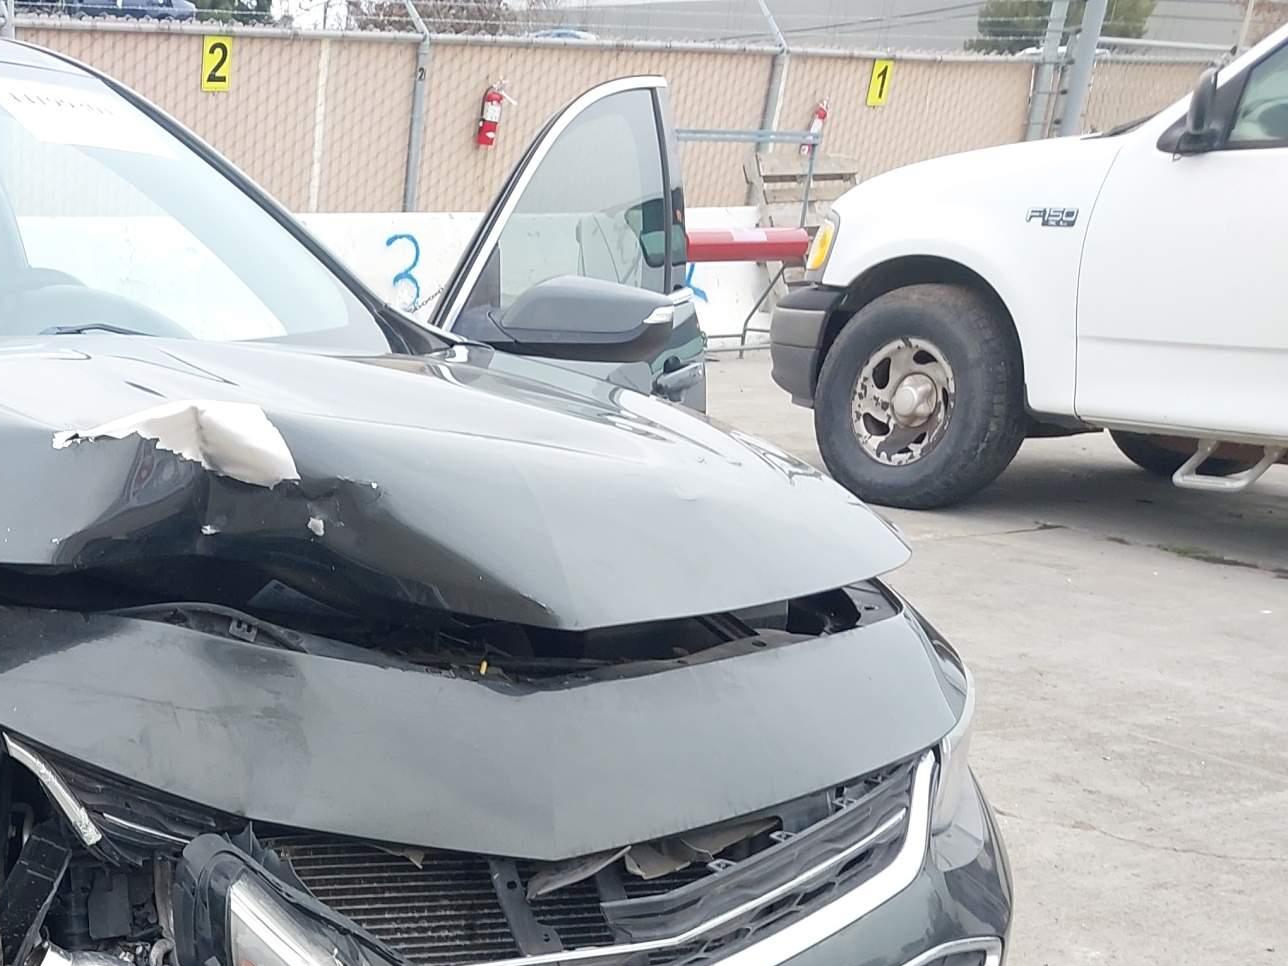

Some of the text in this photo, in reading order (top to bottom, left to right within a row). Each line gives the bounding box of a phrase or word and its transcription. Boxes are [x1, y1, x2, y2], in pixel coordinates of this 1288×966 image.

[206, 42, 228, 83] 2
[877, 65, 889, 99] 1
[386, 234, 420, 313] 3
